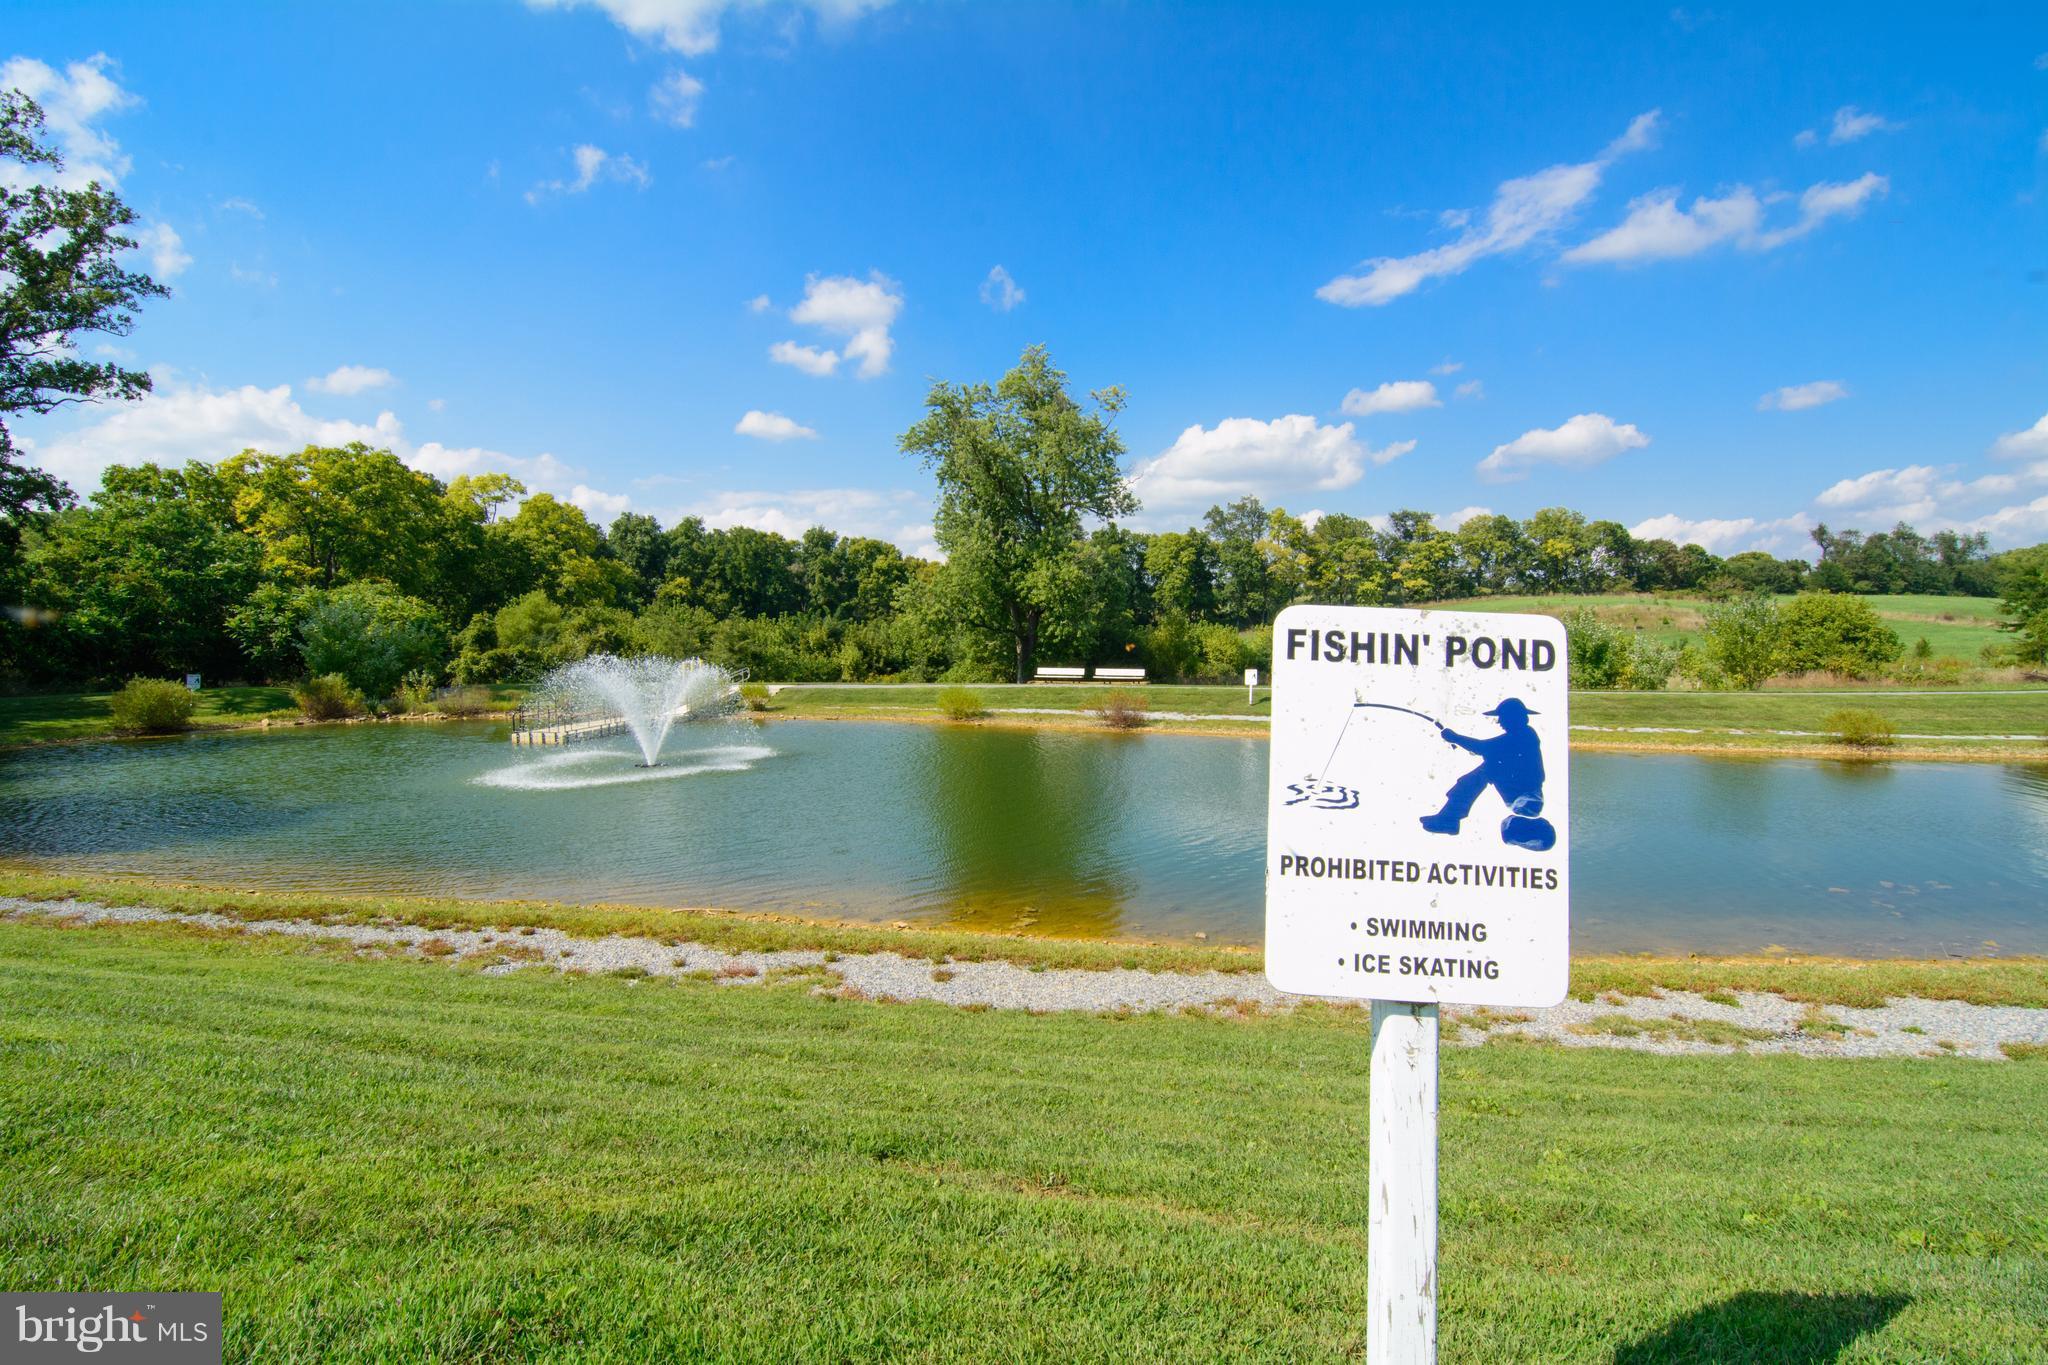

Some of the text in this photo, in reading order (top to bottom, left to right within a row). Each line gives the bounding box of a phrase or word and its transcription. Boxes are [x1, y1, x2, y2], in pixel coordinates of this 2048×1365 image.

[1286, 628, 1557, 672] FISHIN' POND
[1280, 854, 1559, 890] PROHIBITED ACTIVITIES
[1366, 917, 1488, 942] SWIMMING
[1354, 953, 1500, 980] ICE SKATING
